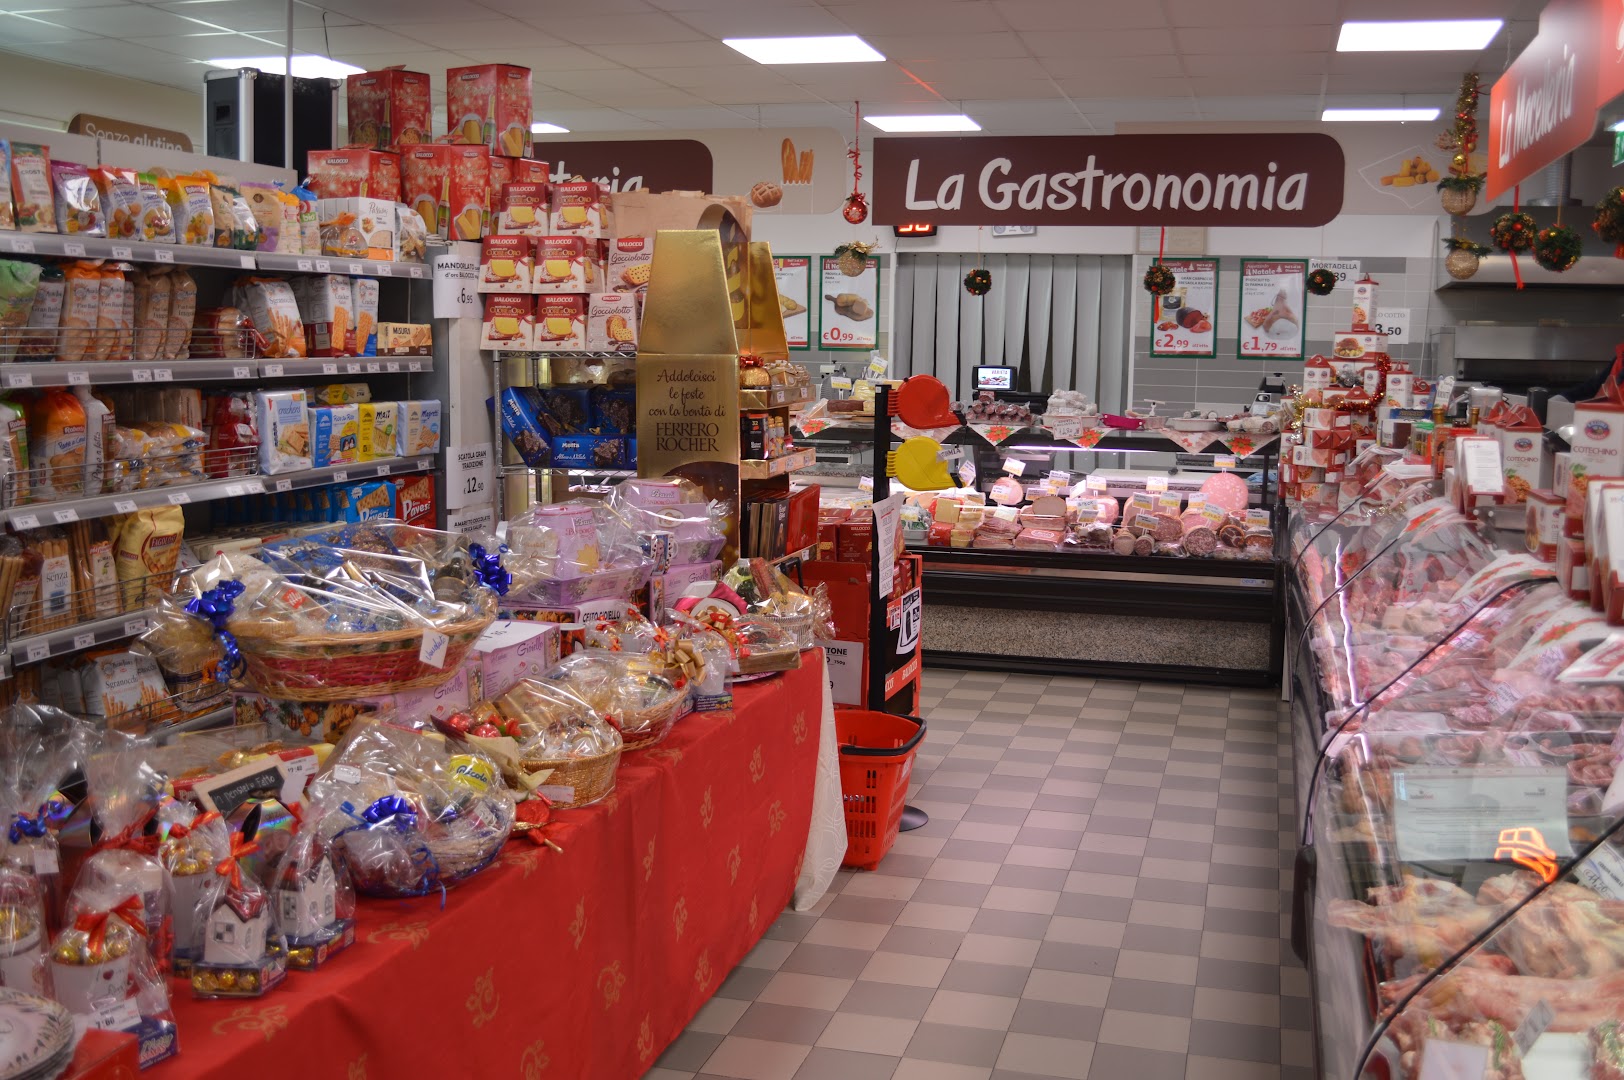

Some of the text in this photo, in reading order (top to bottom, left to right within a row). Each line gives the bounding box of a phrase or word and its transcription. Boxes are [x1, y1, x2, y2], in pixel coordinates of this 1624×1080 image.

[1498, 44, 1576, 169] La Macelleria
[904, 154, 1309, 212] La Gastronomia
[302, 213, 315, 221] bio
[1311, 262, 1358, 270] MORTADELLA
[590, 305, 634, 318] Gocciolotto
[1155, 333, 1189, 349] €2,99
[1242, 336, 1278, 353] €1,79
[656, 369, 717, 383] Addolcisci
[669, 386, 704, 406] le feste
[648, 408, 667, 417] con
[669, 404, 680, 417] la
[714, 404, 727, 417] di
[656, 422, 720, 437] FERRERO
[656, 437, 720, 452] ROCHER
[1573, 445, 1618, 456] COTECHINO
[457, 451, 475, 461] SCATOLA
[1506, 455, 1539, 463] COTECHINO
[402, 499, 431, 521] Pavesi
[151, 534, 177, 548] FAGOLOSI
